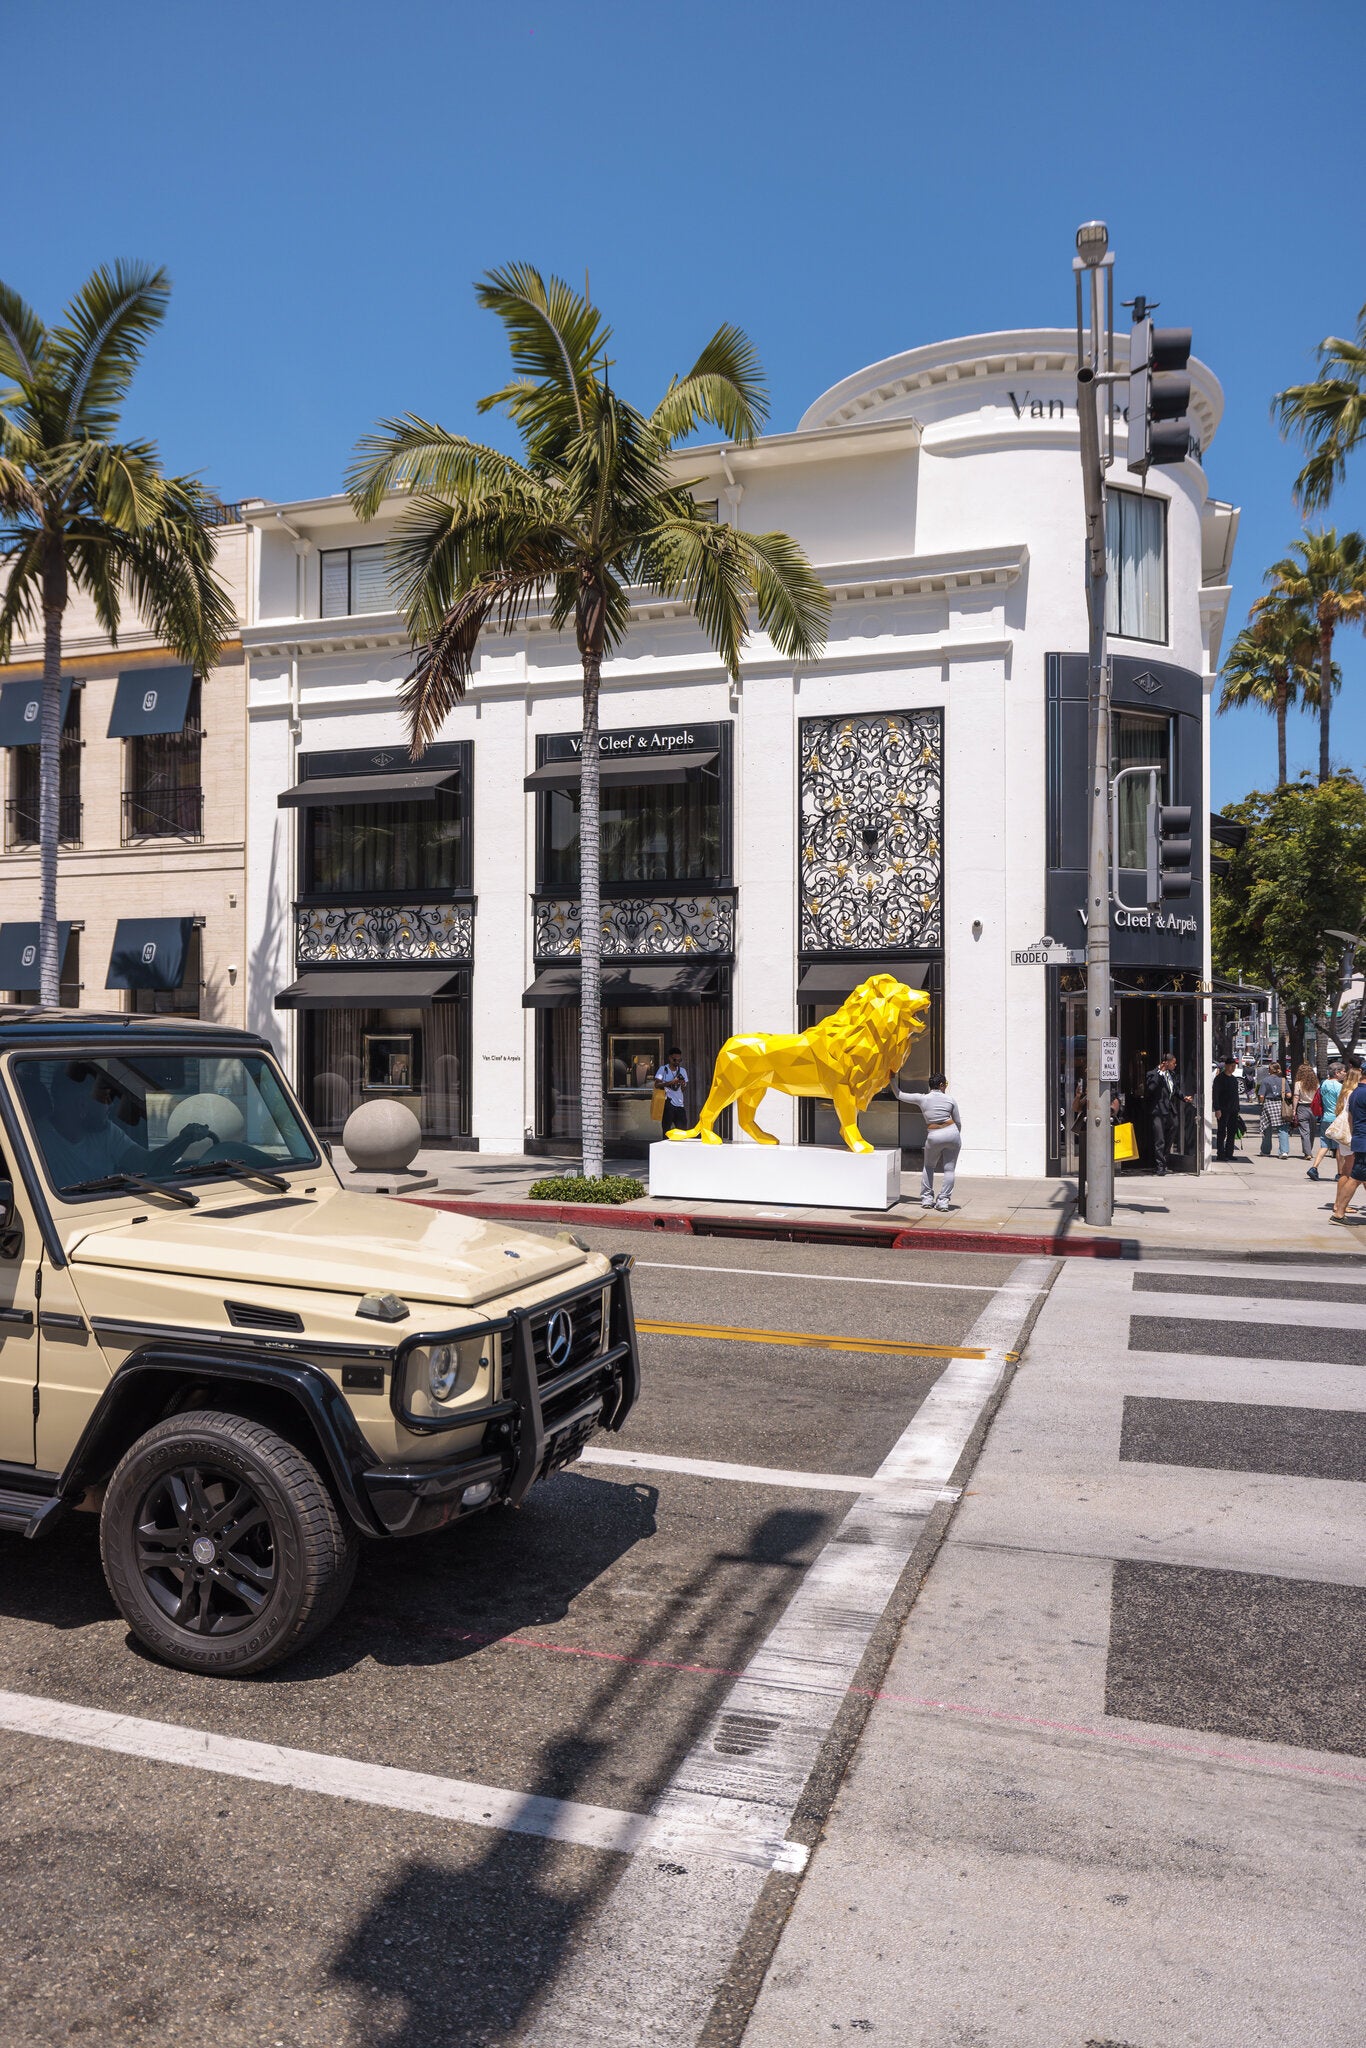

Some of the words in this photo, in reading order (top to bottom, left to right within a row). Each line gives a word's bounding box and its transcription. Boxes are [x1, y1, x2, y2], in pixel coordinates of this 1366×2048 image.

[1007, 390, 1064, 420] Van
[599, 734, 635, 750] Cleef
[637, 736, 648, 748] &
[650, 730, 694, 750] Arpels
[1114, 909, 1153, 928] Cleef
[1166, 912, 1198, 935] Arpels
[1015, 952, 1049, 964] RODEO
[1195, 980, 1214, 993] 300
[166, 1615, 280, 1664] GEOLANDAR
